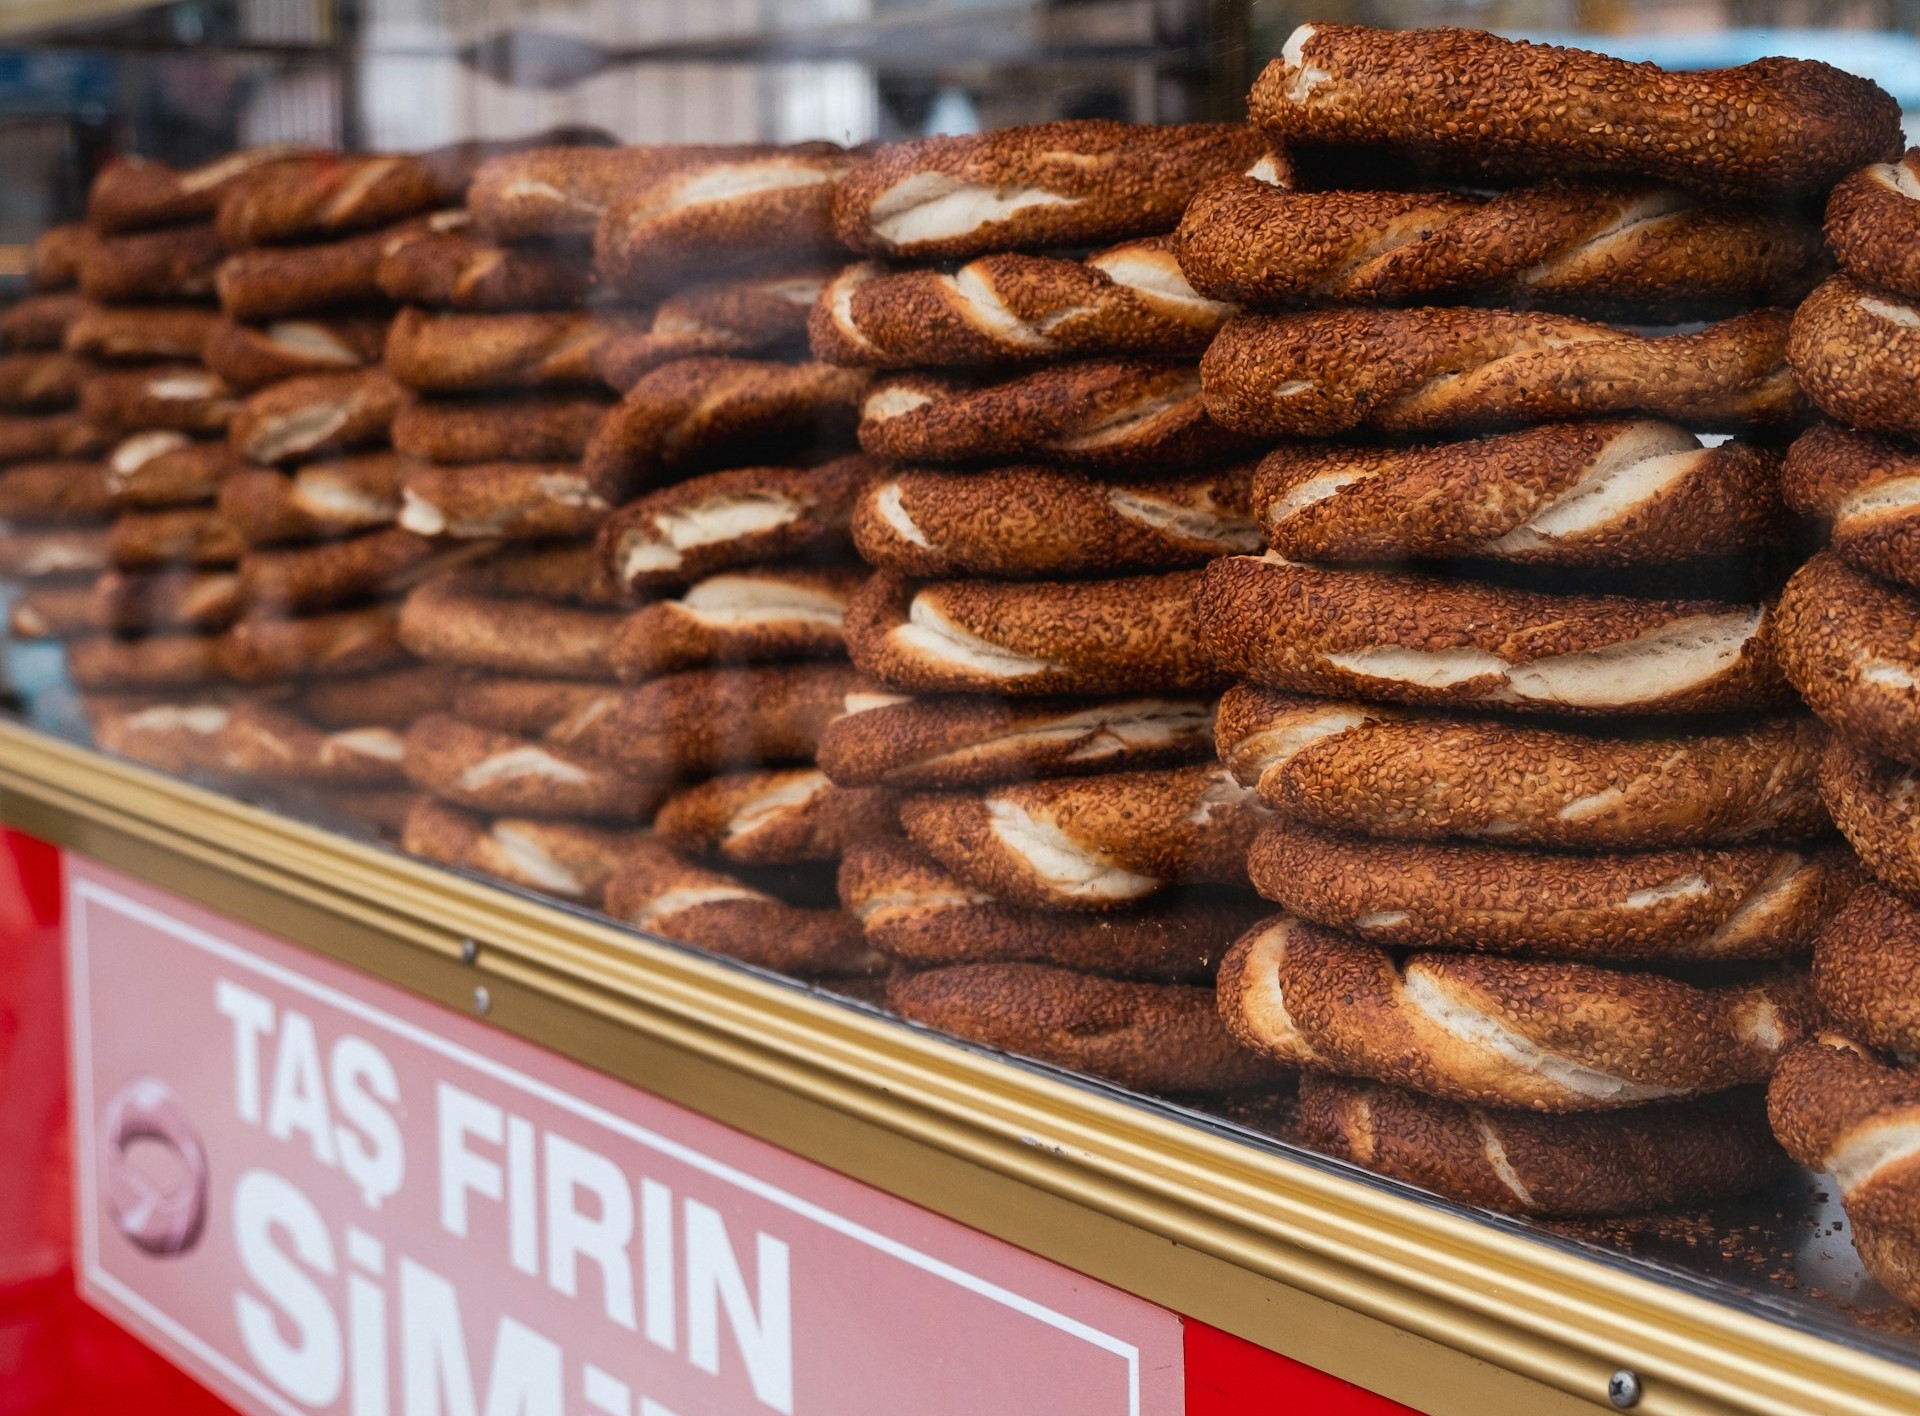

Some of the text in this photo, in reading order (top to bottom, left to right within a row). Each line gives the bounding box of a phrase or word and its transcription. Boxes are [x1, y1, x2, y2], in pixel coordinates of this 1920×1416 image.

[214, 978, 795, 1416] TAŞ FIRIN
[232, 1167, 684, 1416] SiM
